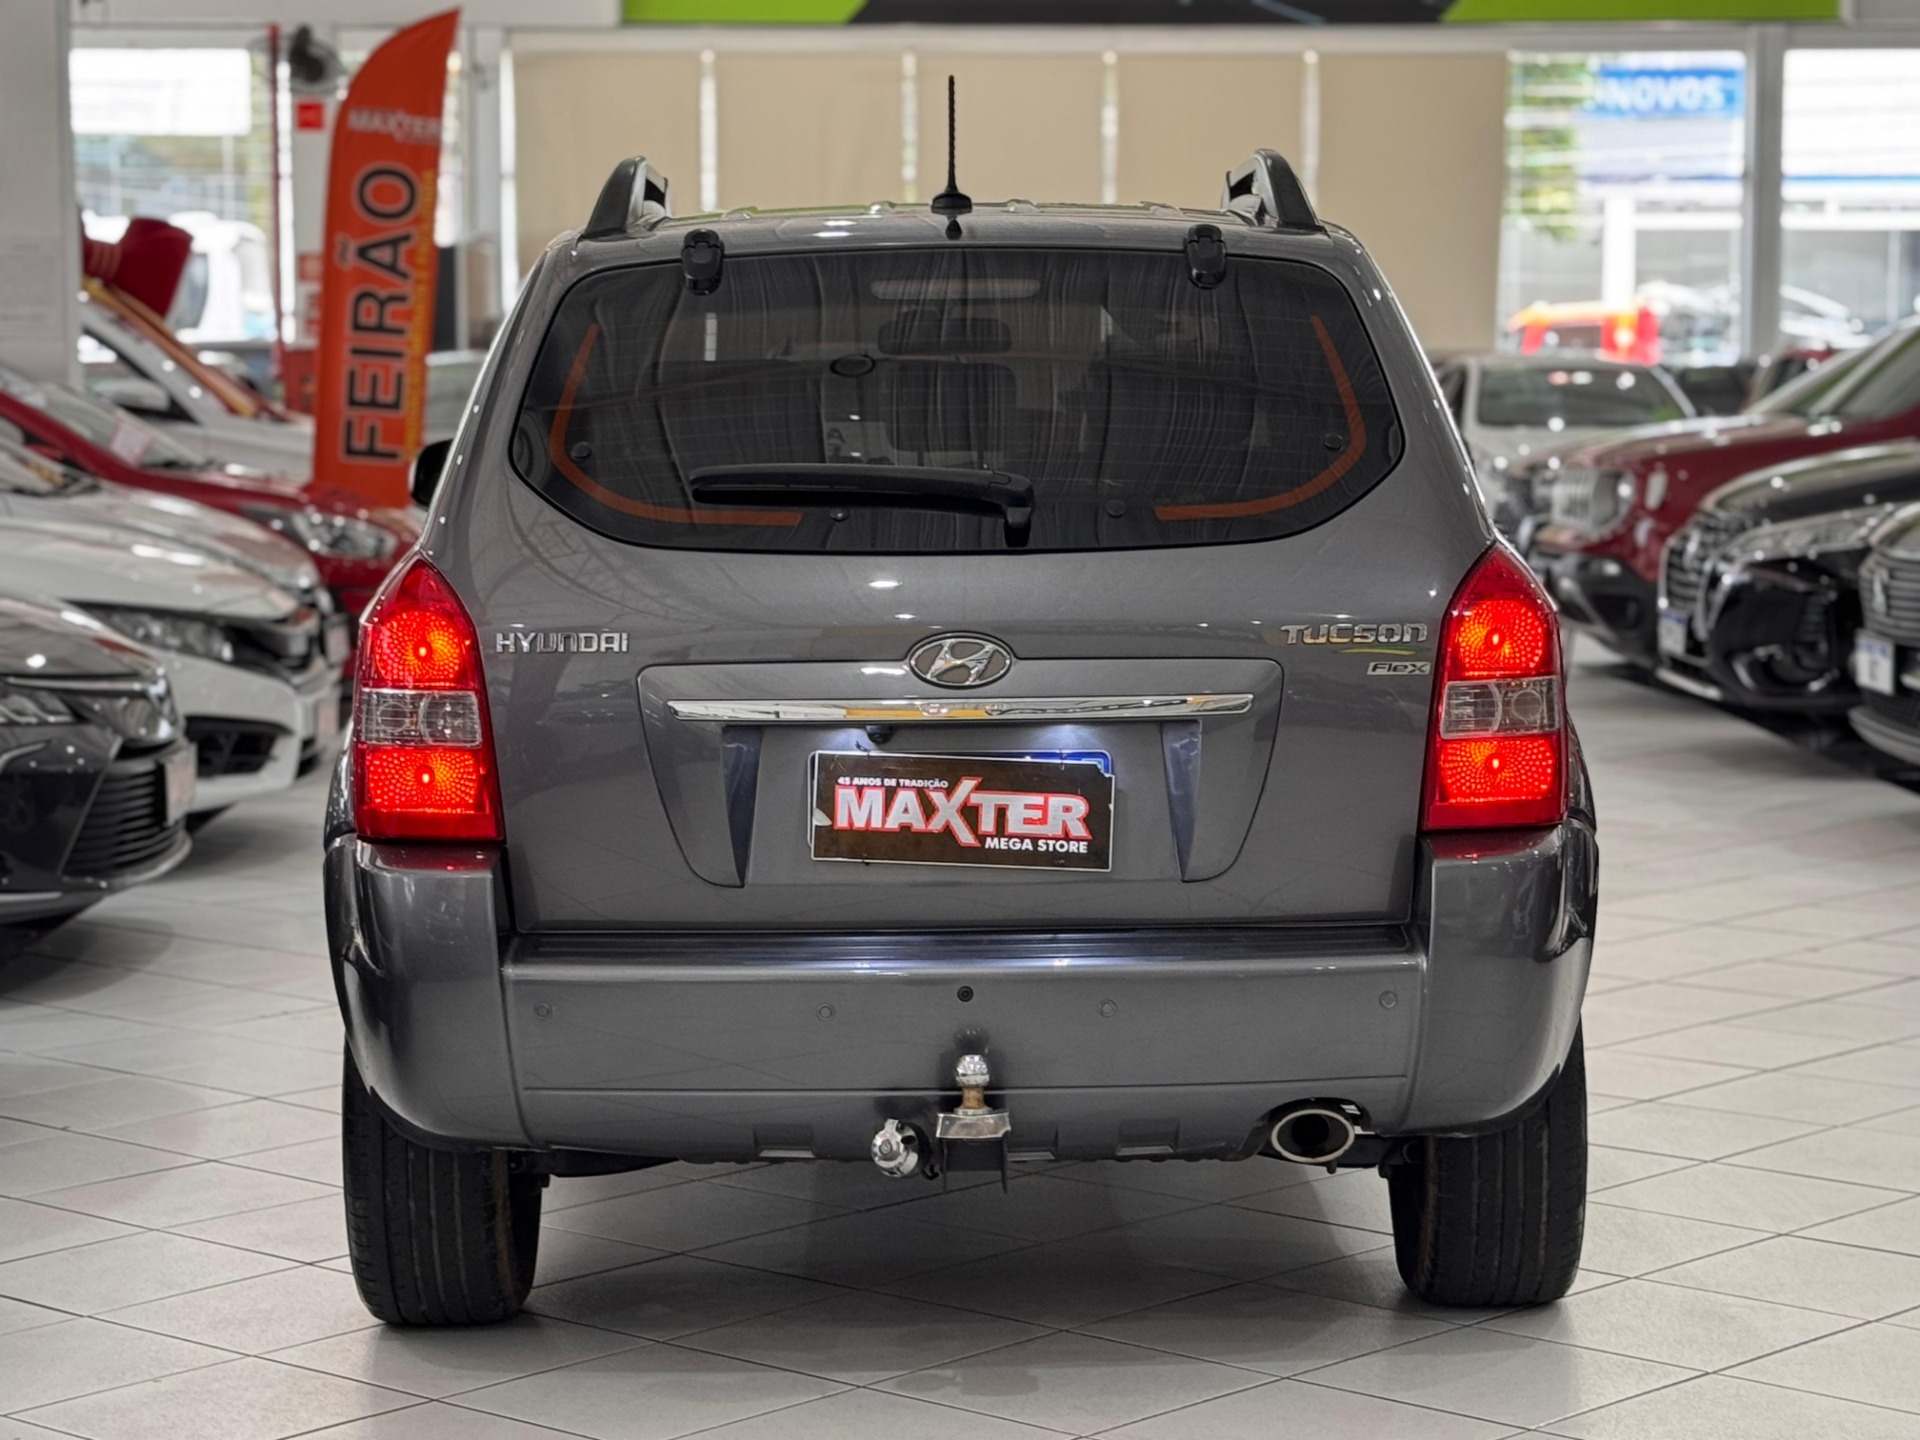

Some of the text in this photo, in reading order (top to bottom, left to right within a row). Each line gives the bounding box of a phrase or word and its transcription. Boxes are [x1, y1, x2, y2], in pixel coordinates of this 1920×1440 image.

[337, 166, 418, 462] FEIRÃO
[495, 632, 629, 653] HYUNDAI
[1280, 623, 1428, 645] TUCSON
[852, 777, 882, 787] ANOS
[883, 778, 897, 787] DE
[898, 778, 949, 790] TRADIÇÃO
[834, 776, 1093, 847] MAXTER
[984, 836, 1089, 854] MEGA STORE
